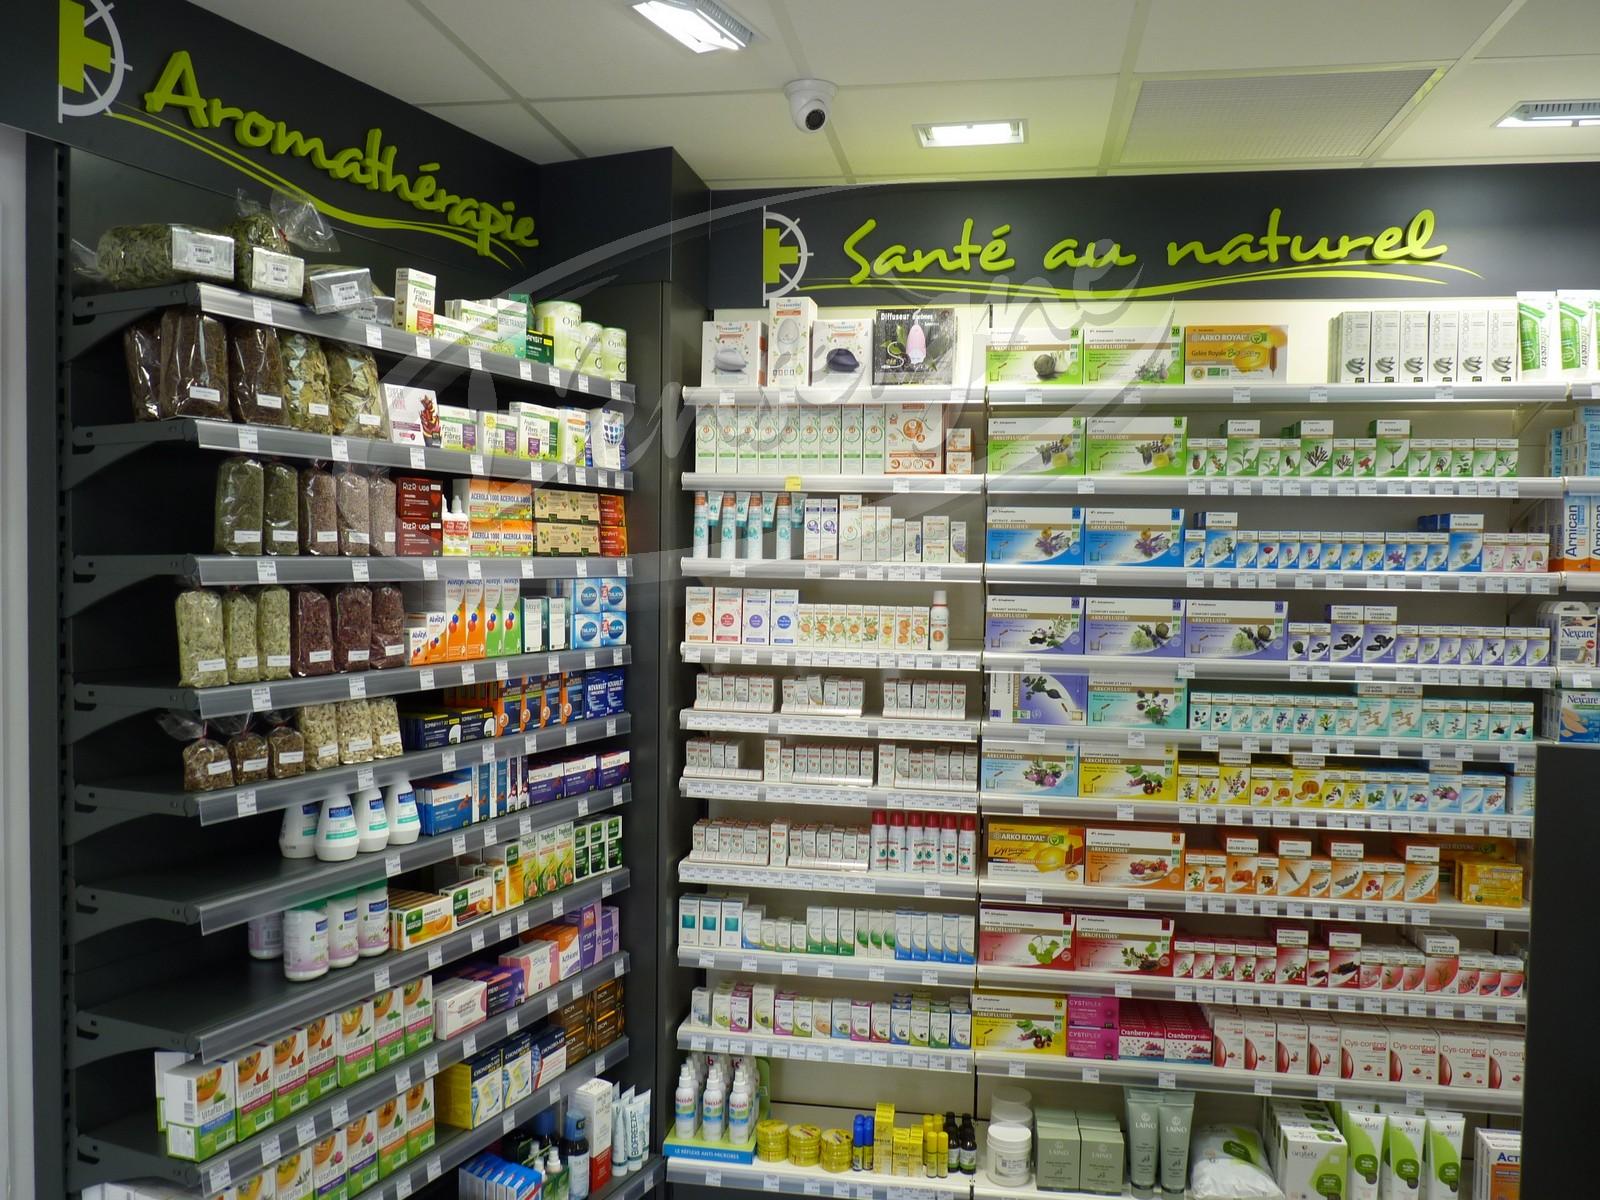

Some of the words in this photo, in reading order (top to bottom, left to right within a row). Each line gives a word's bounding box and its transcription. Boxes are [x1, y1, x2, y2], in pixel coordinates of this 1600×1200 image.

[144, 50, 539, 256] Aromathérapie
[843, 219, 1013, 285] Santé
[1044, 238, 1137, 268] au
[1167, 208, 1447, 272] naturel
[1565, 504, 1578, 557] Arnican
[1563, 628, 1594, 639] Nexcare
[1567, 695, 1599, 706] Nexcare
[1069, 999, 1102, 1007] CYSTIPLEX
[1068, 1031, 1101, 1039] CYSTIPLEX
[1120, 1028, 1150, 1038] Cranberry
[1167, 1032, 1197, 1041] Cranberry
[1344, 1039, 1387, 1049] Cys-control
[1392, 1041, 1436, 1051] Cys-control
[1442, 1045, 1486, 1055] Cys-control
